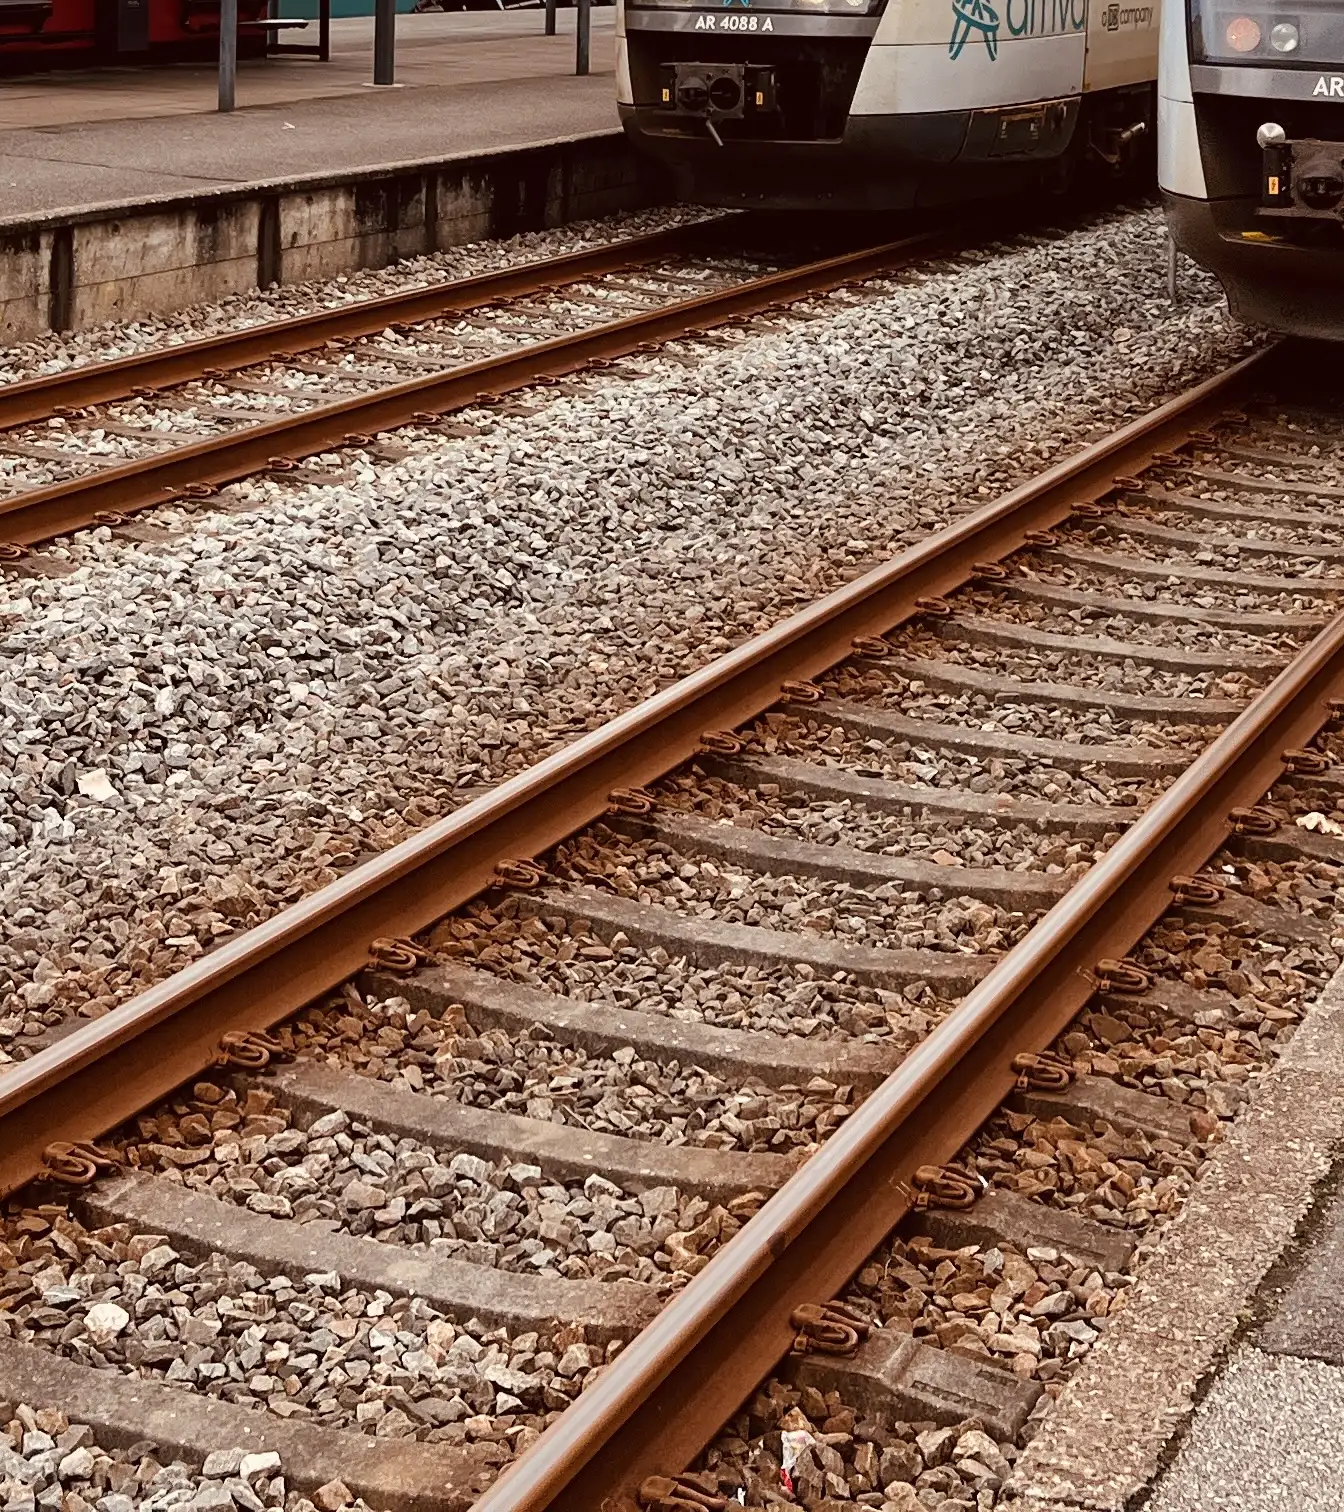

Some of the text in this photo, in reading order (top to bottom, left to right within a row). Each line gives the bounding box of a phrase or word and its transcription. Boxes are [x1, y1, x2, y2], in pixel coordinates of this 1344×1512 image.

[695, 15, 774, 31] AR 4088 A
[1101, 11, 1107, 27] a
[1120, 6, 1154, 31] company
[1312, 76, 1344, 97] AR
